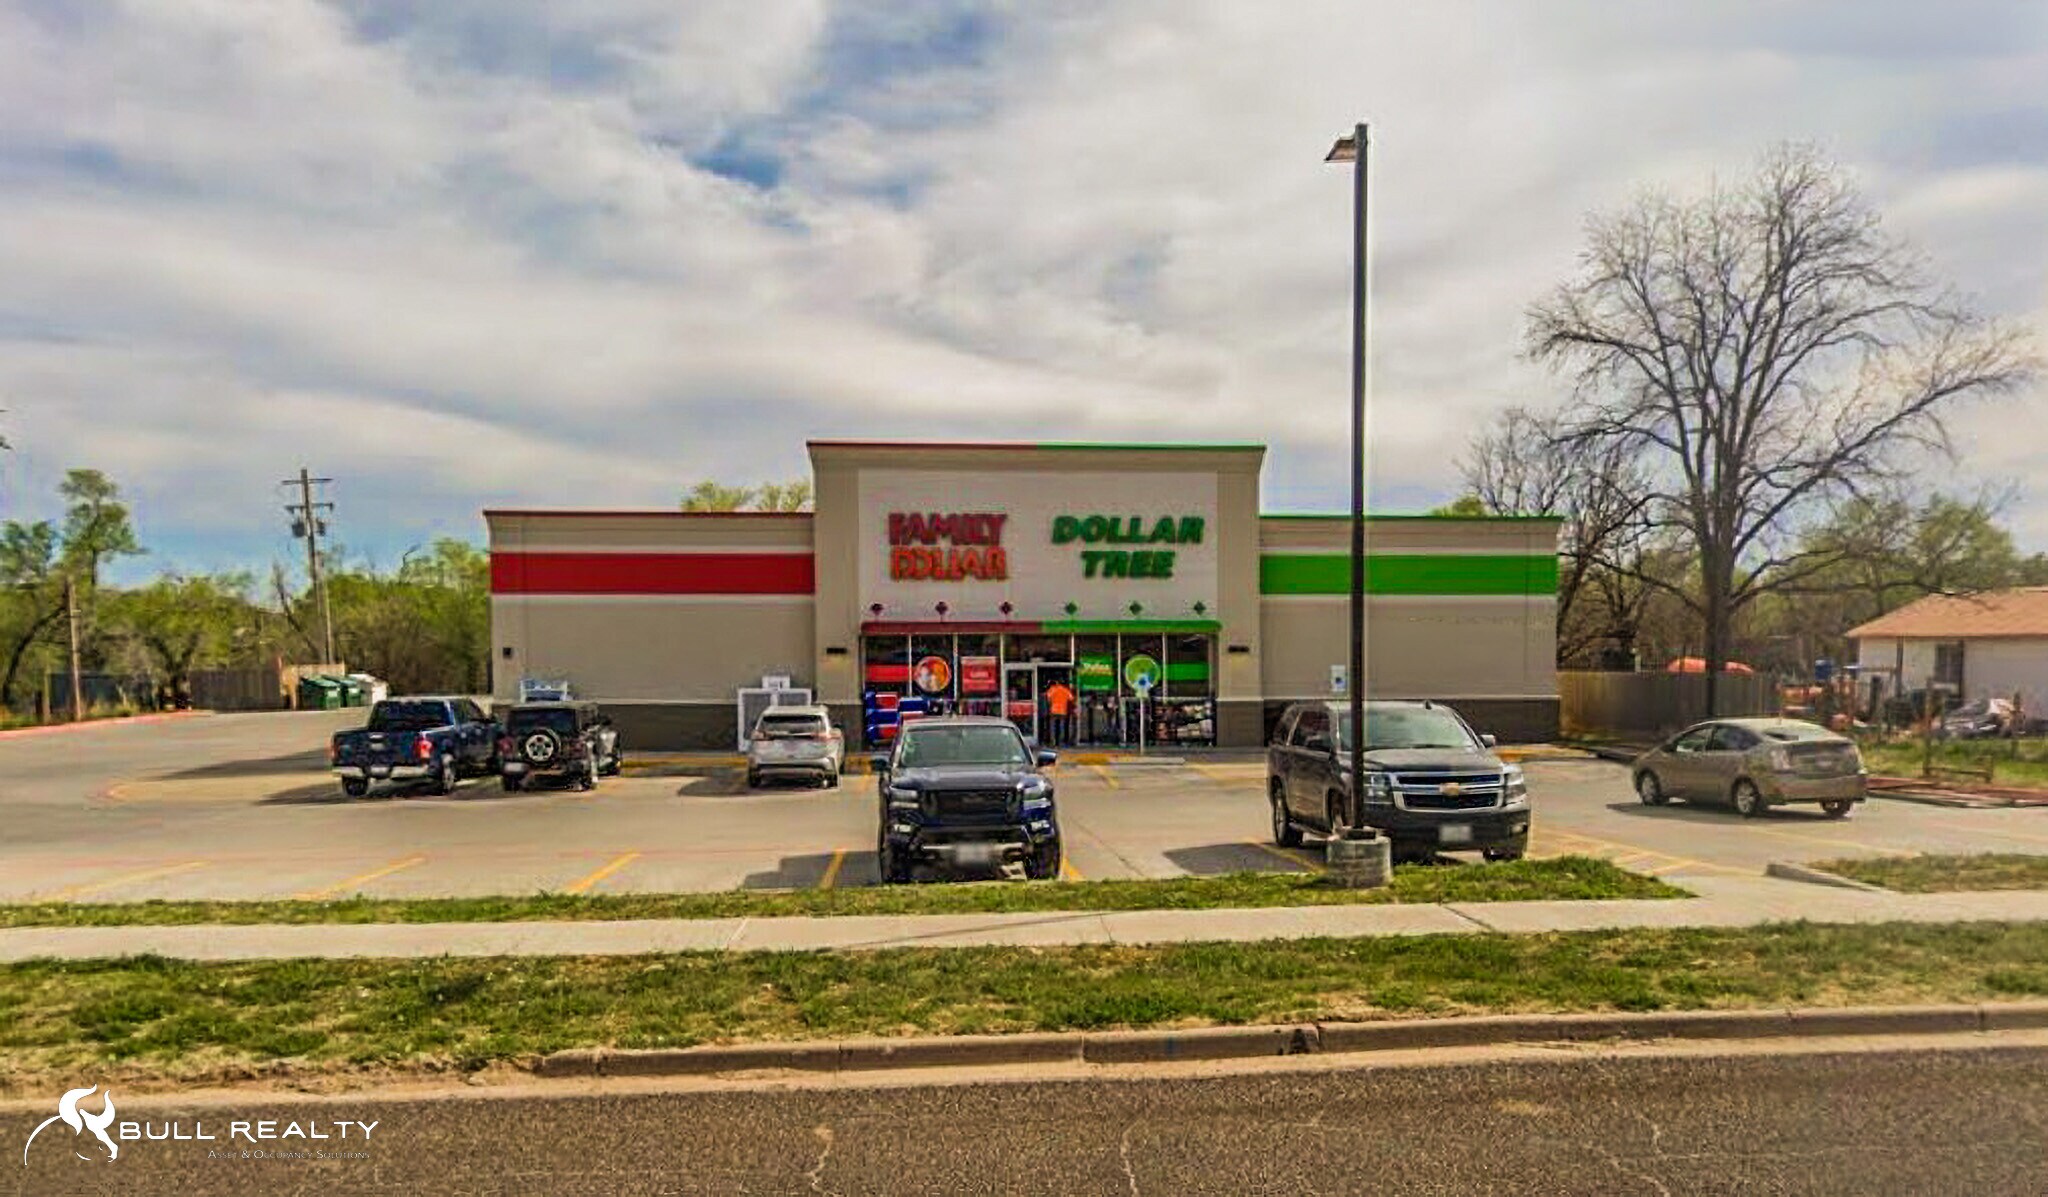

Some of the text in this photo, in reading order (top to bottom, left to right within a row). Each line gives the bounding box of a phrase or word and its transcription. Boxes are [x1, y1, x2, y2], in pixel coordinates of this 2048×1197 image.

[888, 513, 1007, 545] FAMILY
[1052, 515, 1204, 544] DOLLAR
[890, 546, 1008, 581] DOLLAR
[1082, 551, 1175, 578] TREE
